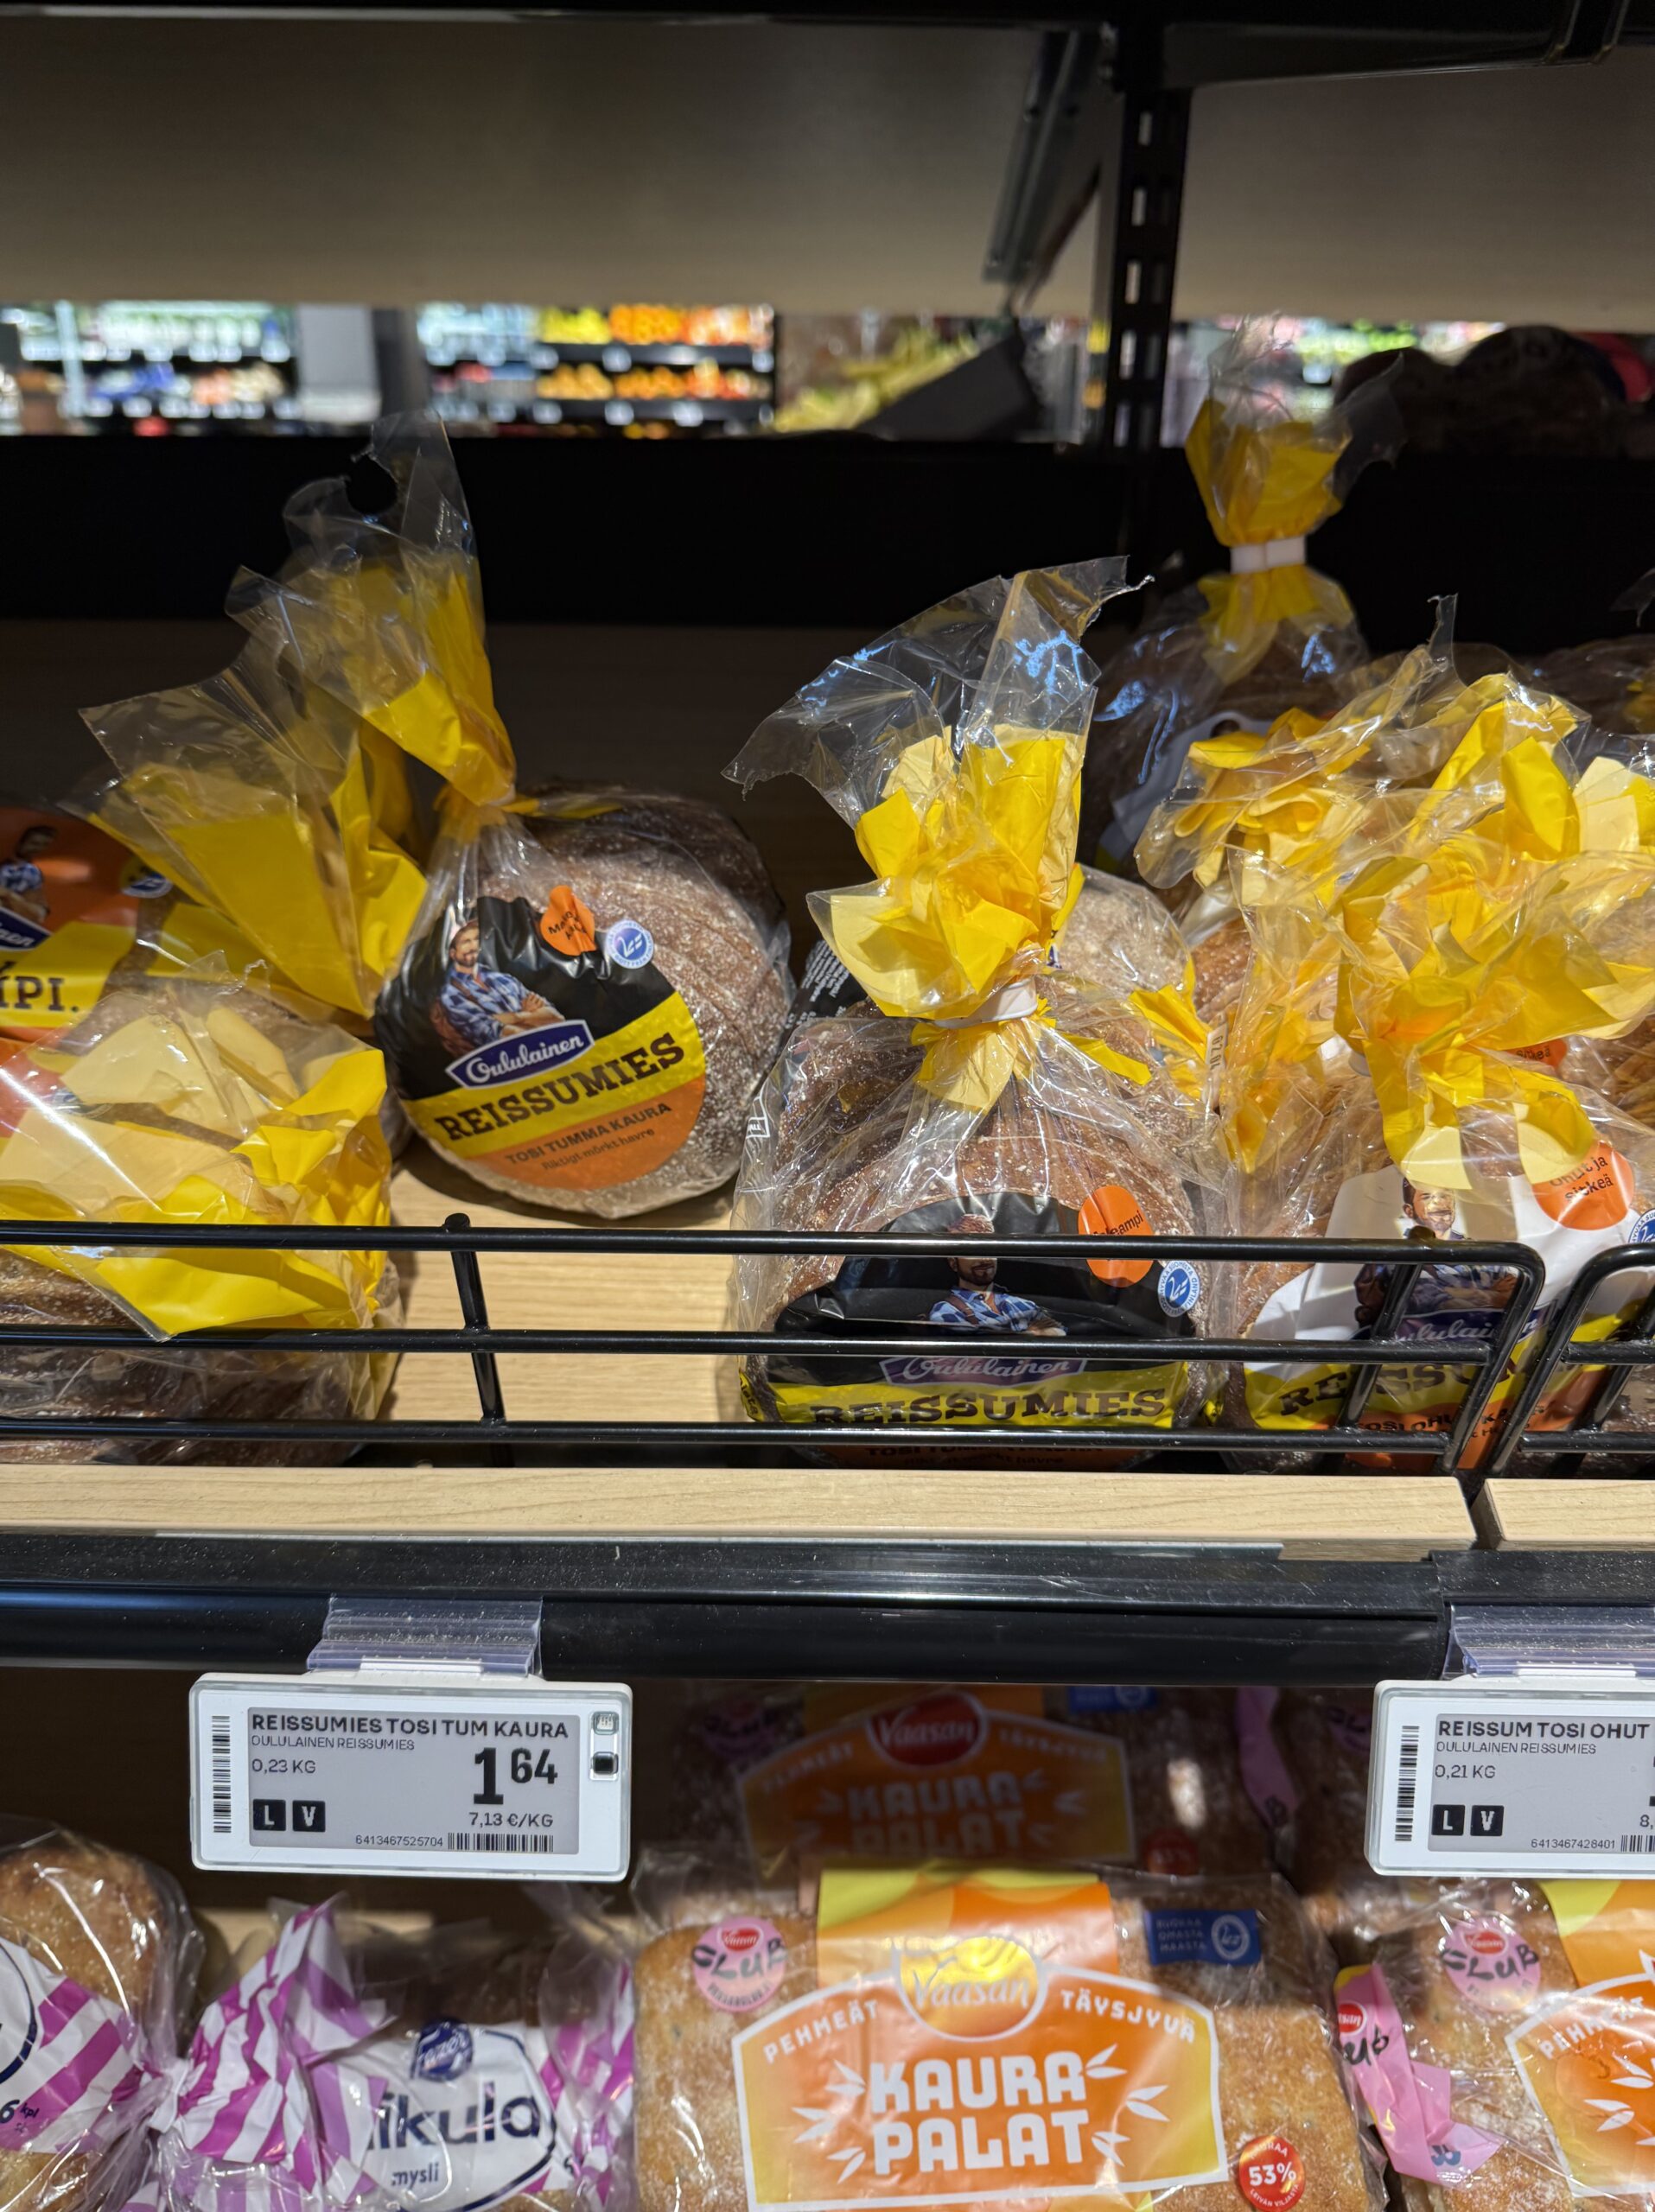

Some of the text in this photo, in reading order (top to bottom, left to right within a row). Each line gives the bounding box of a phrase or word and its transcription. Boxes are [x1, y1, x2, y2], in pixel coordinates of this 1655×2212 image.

[466, 1033, 584, 1084] Oululainen
[435, 1033, 684, 1141] REISSUMIES
[506, 1103, 672, 1165] TOSI TUMMA KAURA
[582, 1139, 620, 1159] mörkt
[619, 1128, 655, 1146] havre
[1593, 1156, 1608, 1171] ja
[1565, 1174, 1614, 1199] sitkeä
[904, 1356, 1072, 1383] Oululainen
[810, 1388, 1166, 1424] REISSUMIES
[252, 1714, 569, 1739] REISSUMIES TOSI TUM KAURA
[877, 1707, 977, 1751] Vaasan
[1438, 1720, 1651, 1739] REISSUM TOSI OHUT
[251, 1735, 415, 1751] OULULAINEN REISSUMIES
[1436, 1741, 1596, 1755] OULULAINEN REISSUMIES
[251, 1758, 316, 1775] 0,23 KG
[473, 1747, 558, 1805] 1 64
[1435, 1764, 1496, 1780] 0,21 KG
[846, 1770, 1022, 1820] KAURA
[468, 1812, 553, 1830] 7,13 €/KG
[355, 1834, 443, 1847] 6413467525704
[1531, 1838, 1615, 1850] 6413467428401
[913, 1967, 1030, 2009] Vaasan
[765, 1988, 1196, 2063] PEHMEÄT TÄYSJYVÄ
[870, 2051, 1087, 2114] KAURA
[0, 2099, 40, 2124] 6 kpl
[873, 2110, 1090, 2176] PALAT
[1249, 2162, 1296, 2187] 53%
